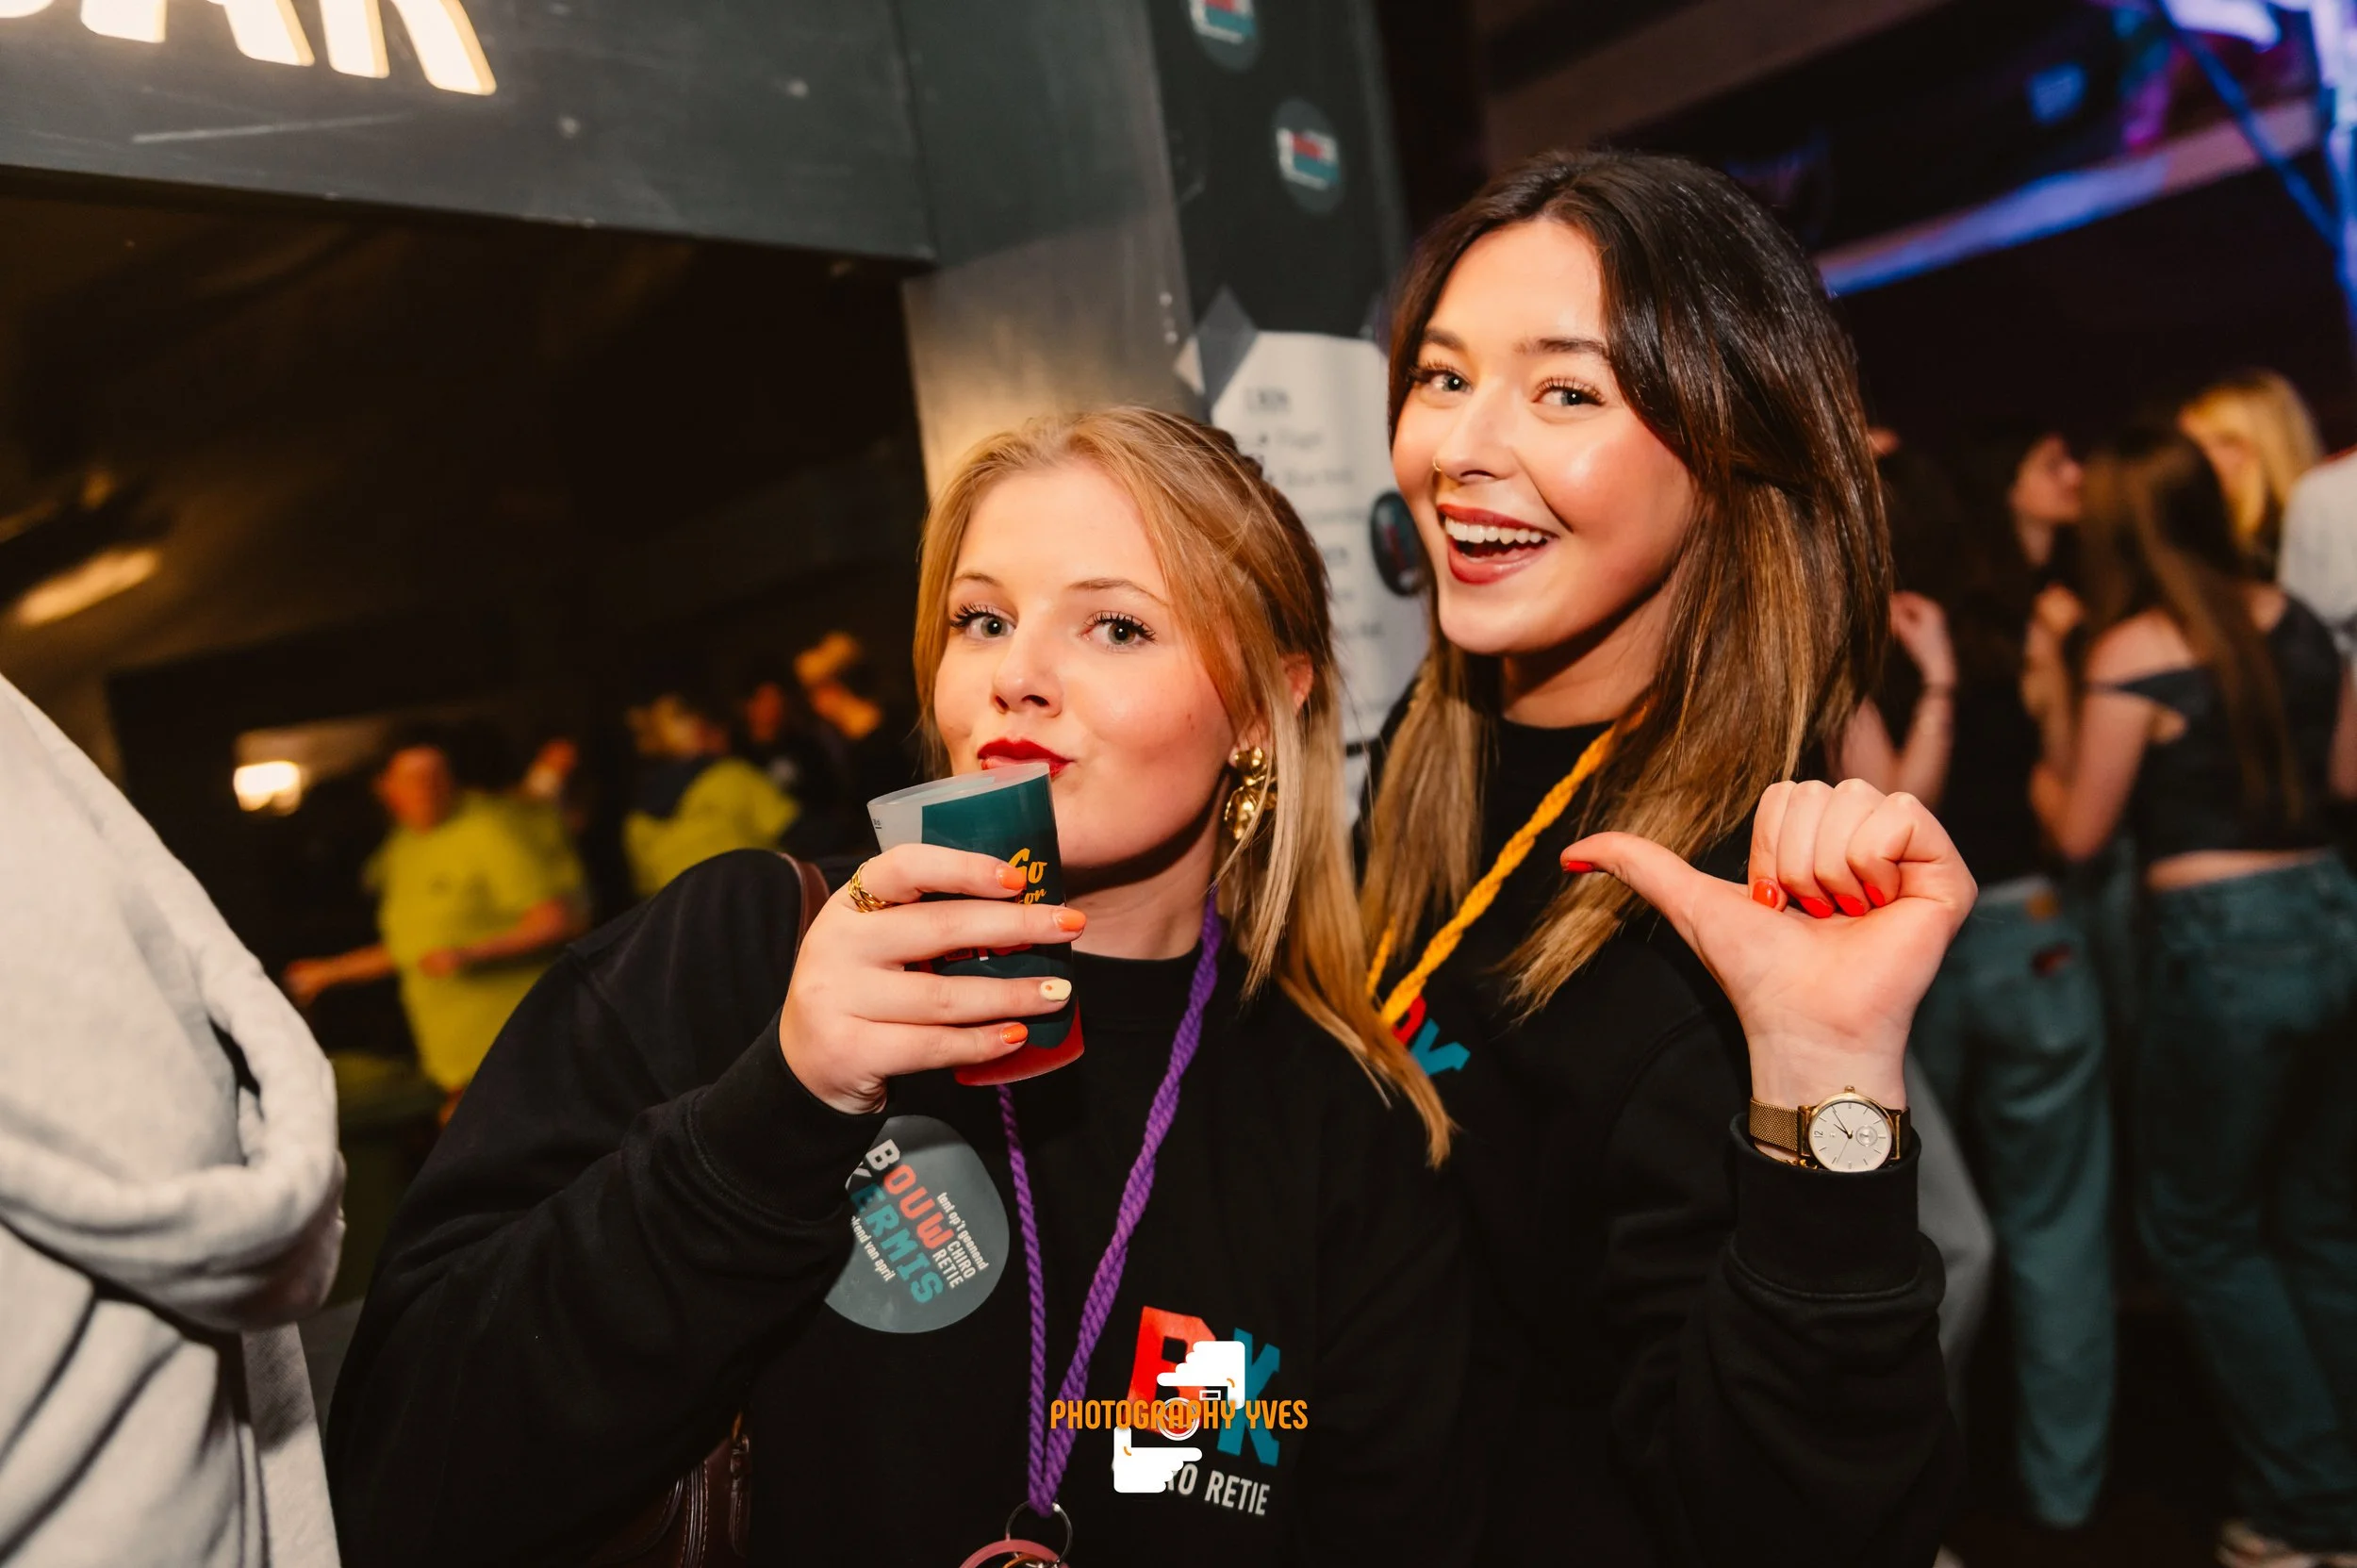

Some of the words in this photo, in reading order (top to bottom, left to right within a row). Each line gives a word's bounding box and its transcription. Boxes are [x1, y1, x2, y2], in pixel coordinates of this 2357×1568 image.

[865, 1138, 955, 1250] BOUW
[937, 1192, 955, 1213] tent
[864, 1241, 880, 1260] van
[875, 1259, 896, 1281] april
[932, 1248, 964, 1289] RETIE
[948, 1240, 976, 1279] CHIRO
[1204, 1469, 1271, 1516] RETIE
